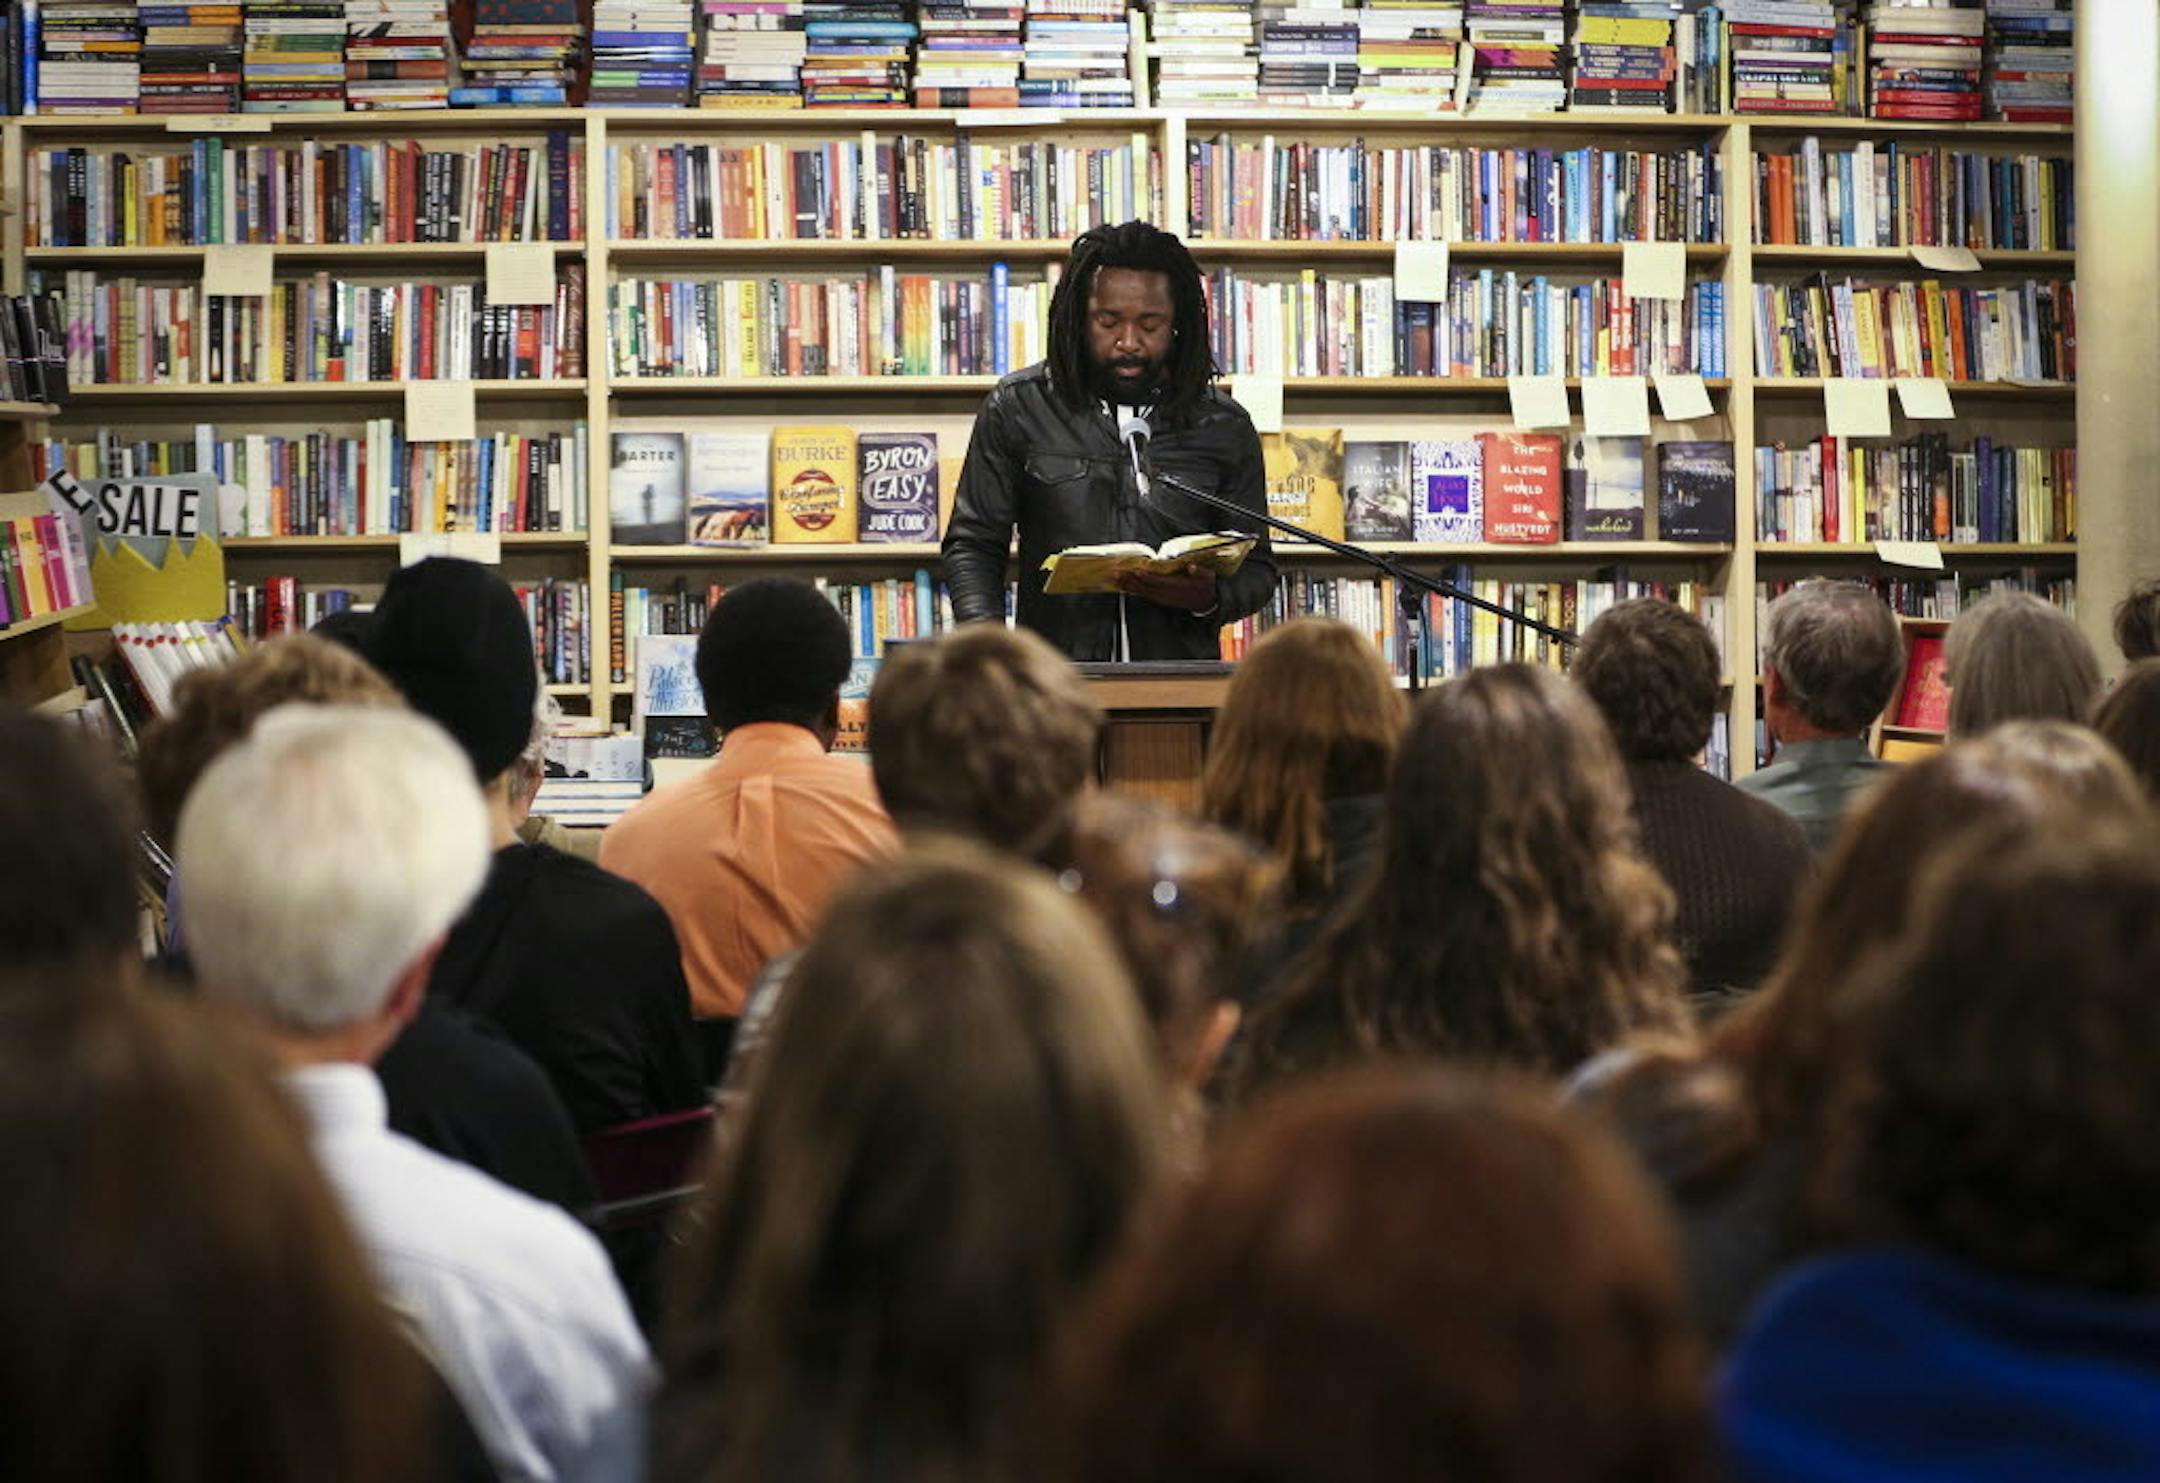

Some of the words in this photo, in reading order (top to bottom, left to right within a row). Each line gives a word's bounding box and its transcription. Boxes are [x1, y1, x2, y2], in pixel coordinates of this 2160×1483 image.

[619, 451, 676, 462] BARTER
[777, 446, 847, 462] BURKE
[1513, 446, 1534, 455] THE
[864, 446, 929, 474] BYRON
[1352, 464, 1401, 476] ITALIAN
[1500, 465, 1547, 475] BLAZING
[873, 474, 926, 503] EASY
[1363, 478, 1392, 489] WIFE
[1503, 484, 1543, 495] WORLD
[97, 483, 199, 538] SALE
[1512, 503, 1533, 513] SIRI
[868, 514, 896, 531] JUDE
[898, 514, 925, 531] COOK
[610, 591, 625, 635] FALLEN
